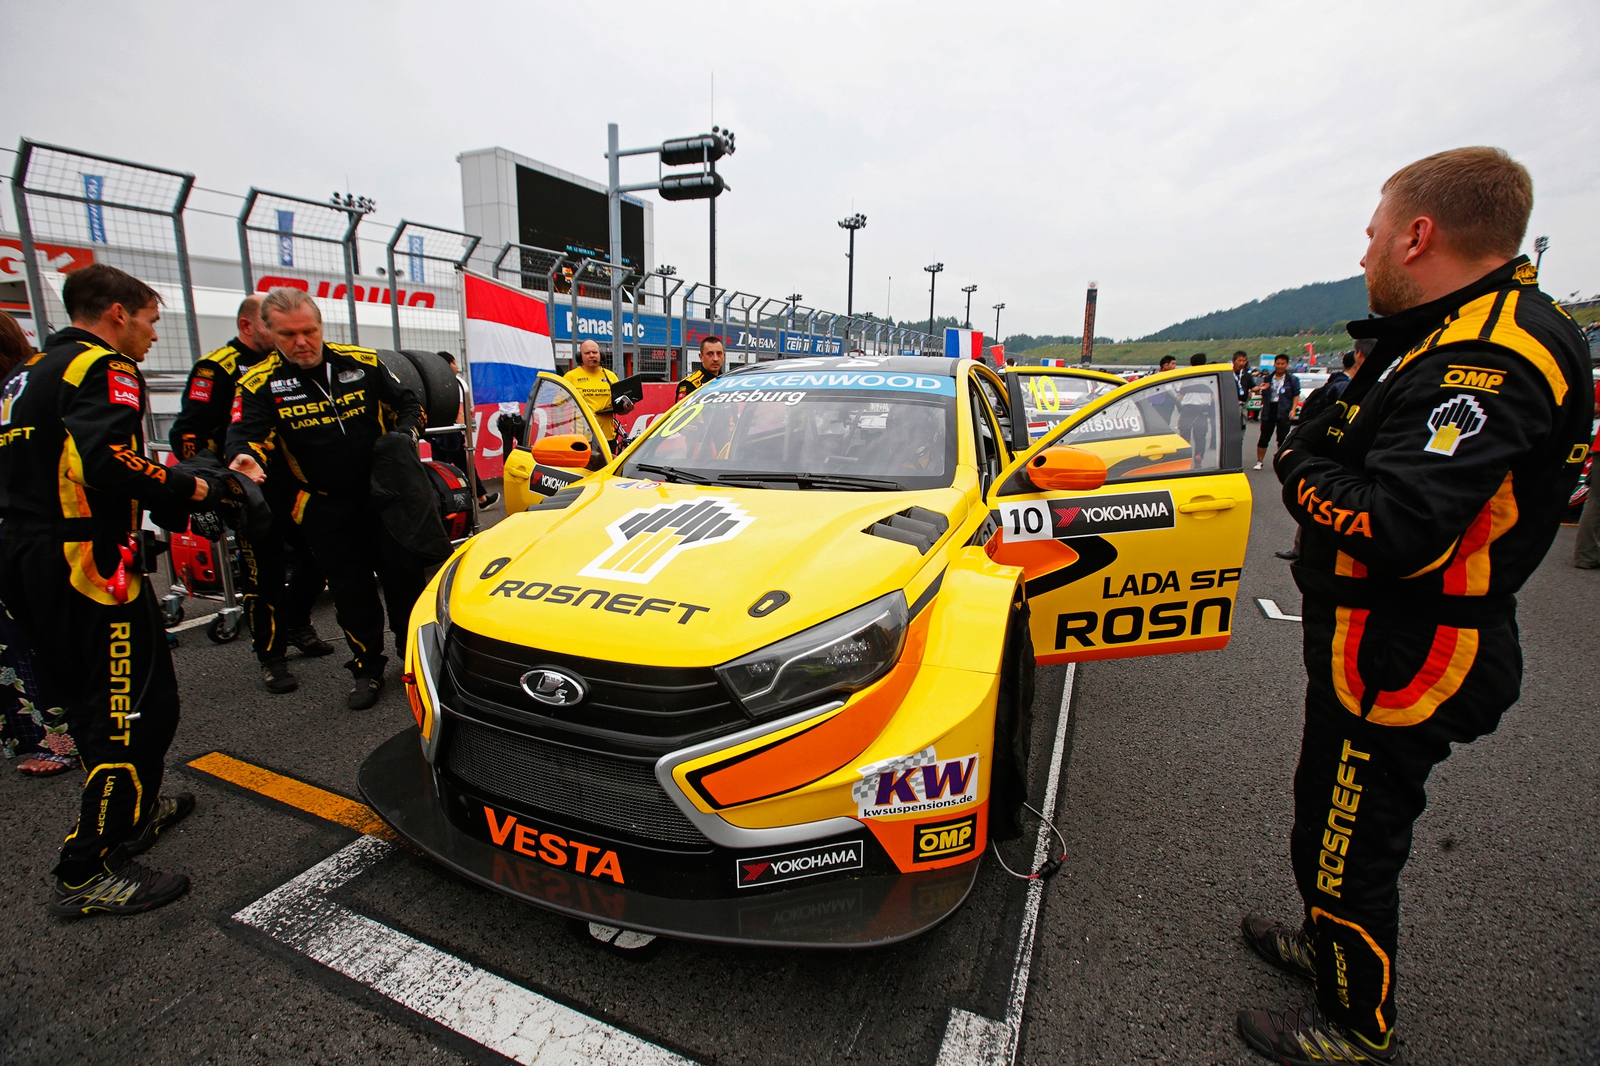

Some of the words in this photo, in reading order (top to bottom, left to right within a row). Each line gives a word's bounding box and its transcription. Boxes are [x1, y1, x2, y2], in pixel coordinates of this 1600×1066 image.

[1027, 375, 1060, 412] 10
[1443, 369, 1504, 389] OMP
[700, 389, 807, 406] Catsburg
[290, 418, 320, 430] LADA
[1009, 507, 1044, 535] 10
[1081, 501, 1169, 524] YOKOHAMA
[1296, 477, 1373, 538] VESTA
[1102, 570, 1181, 600] LADA
[489, 579, 711, 625] ROSNEFT
[109, 621, 131, 746] ROSNEFT
[104, 775, 116, 798] LADA
[874, 755, 979, 806] KW
[97, 799, 109, 835] SPORT
[863, 794, 973, 817] kwsuspensions.de
[1316, 739, 1371, 898] ROSNEFT
[483, 806, 625, 885] VESTA
[919, 826, 972, 852] OMP
[770, 849, 857, 875] YOKOHAMA
